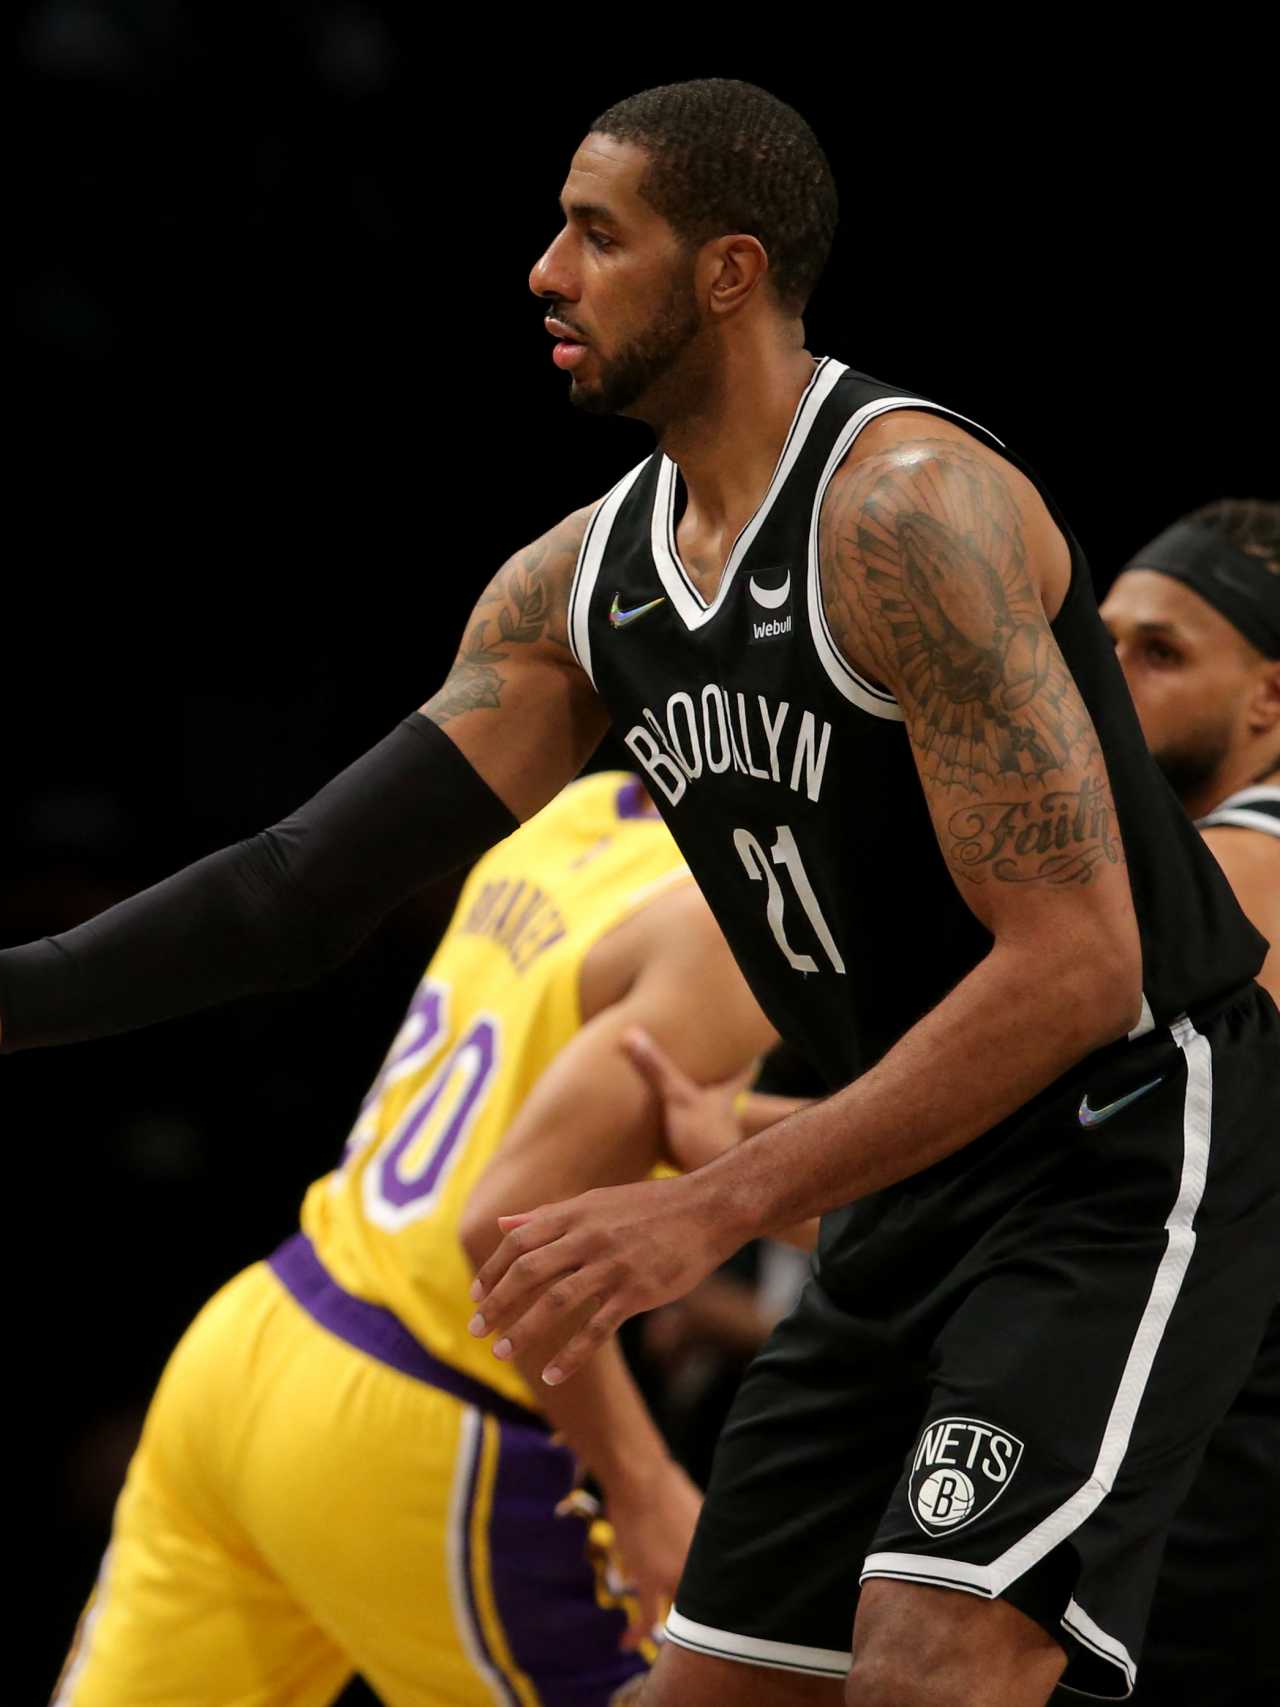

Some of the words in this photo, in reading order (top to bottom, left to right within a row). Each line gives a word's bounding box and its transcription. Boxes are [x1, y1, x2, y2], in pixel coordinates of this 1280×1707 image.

[753, 615, 792, 639] Webull
[948, 776, 1119, 866] Faith
[733, 825, 846, 974] 21
[915, 1423, 1013, 1483] NETS
[931, 1476, 957, 1518] B
